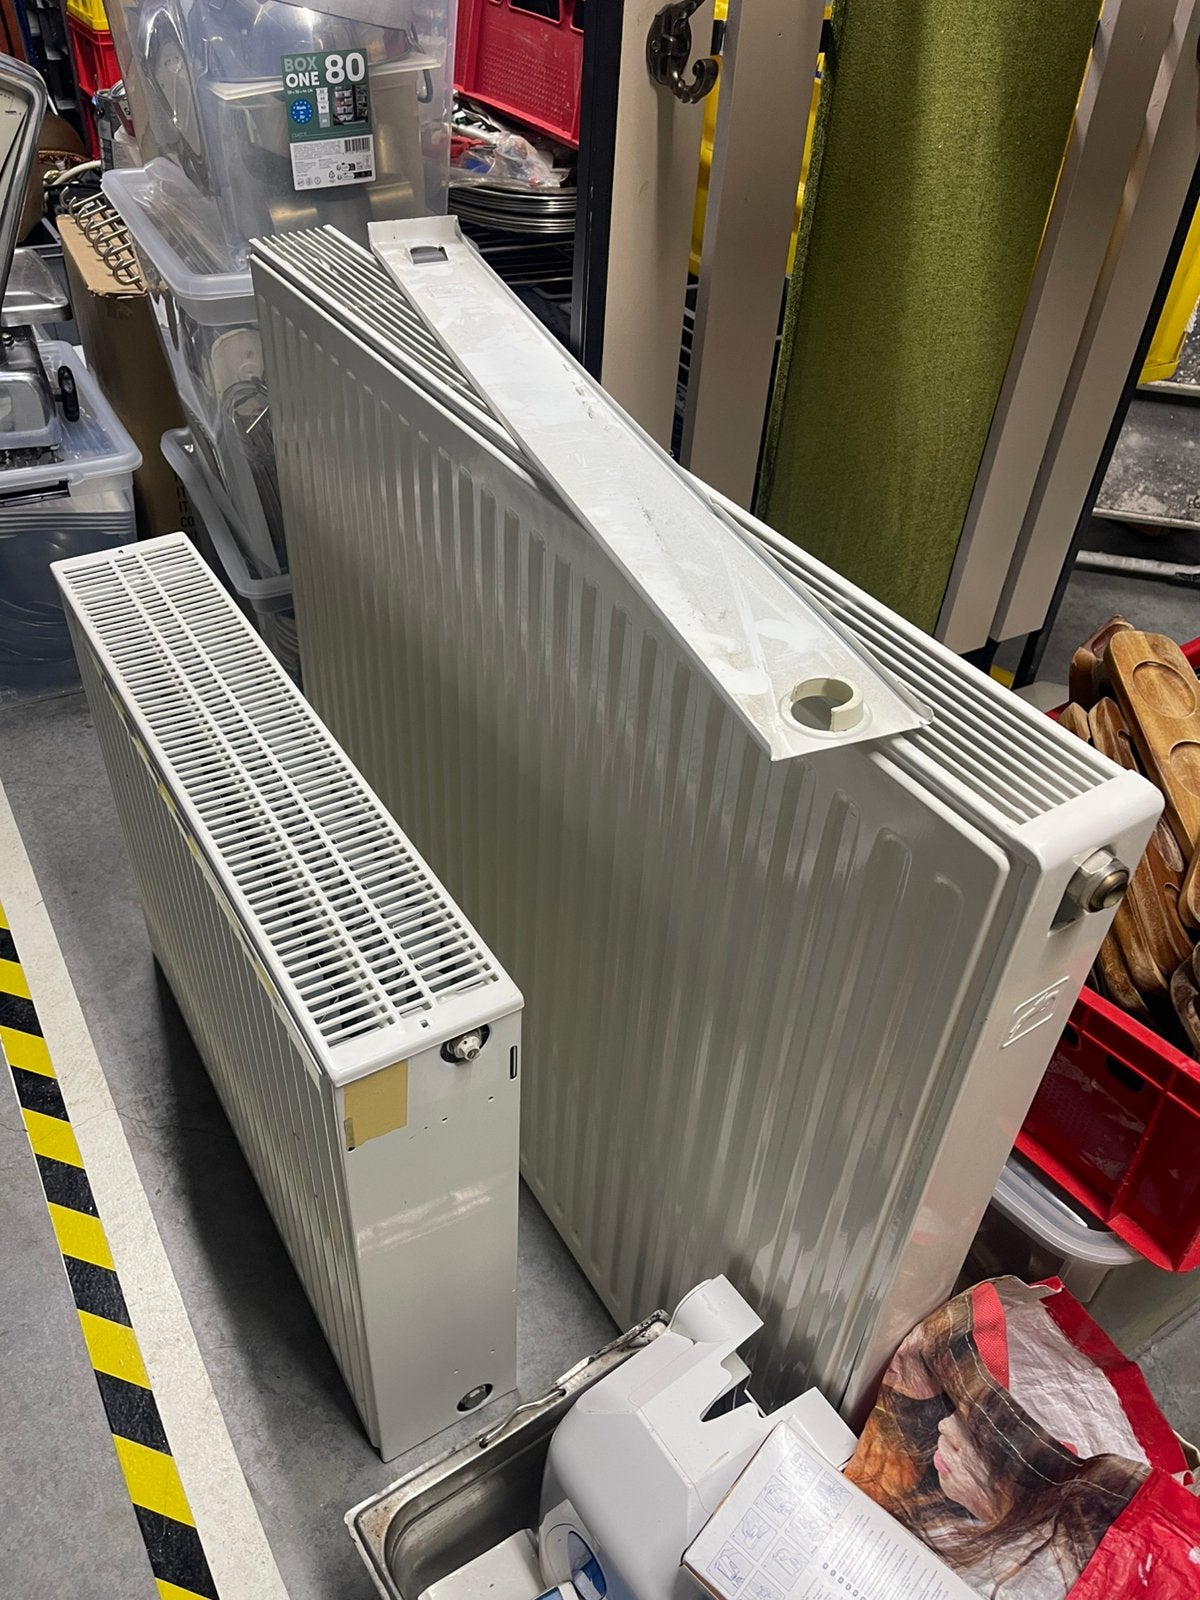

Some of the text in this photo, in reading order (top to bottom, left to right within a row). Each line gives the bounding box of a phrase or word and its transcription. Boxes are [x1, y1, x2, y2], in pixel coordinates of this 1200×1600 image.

[284, 56, 318, 73] BOX
[324, 52, 365, 84] 80
[285, 71, 320, 88] ONE
